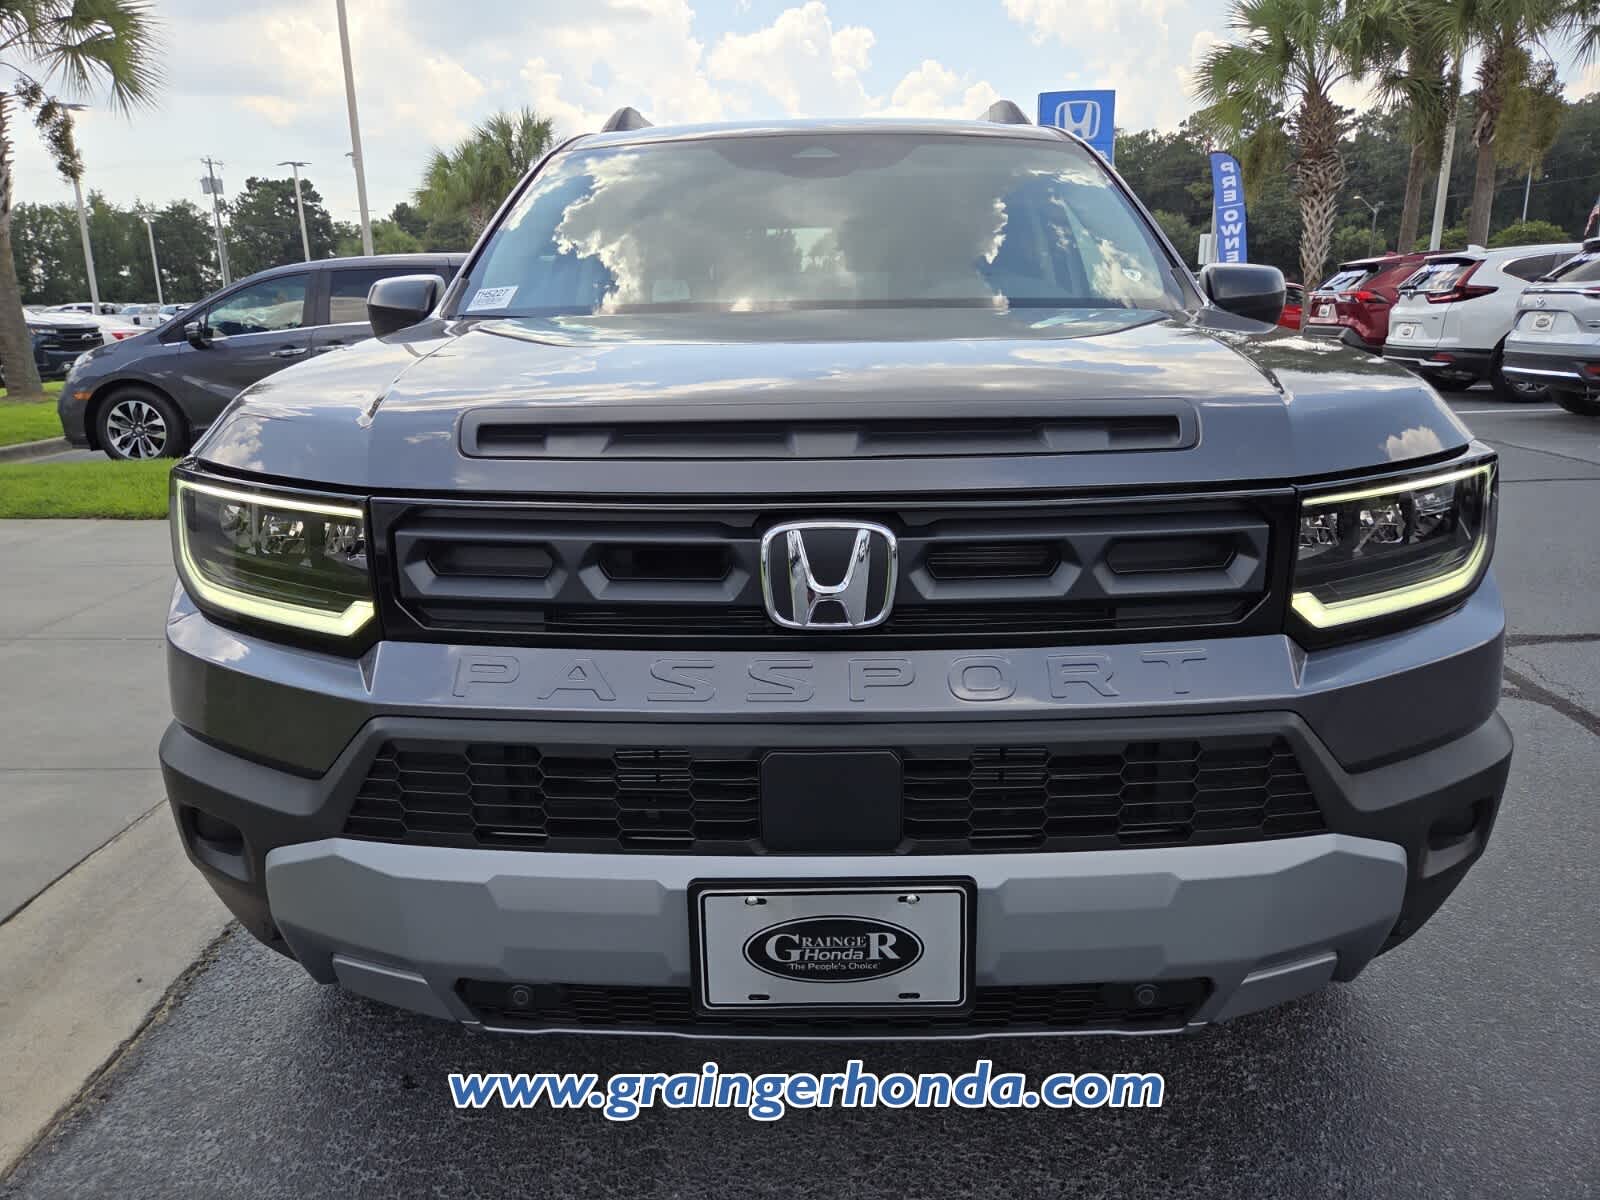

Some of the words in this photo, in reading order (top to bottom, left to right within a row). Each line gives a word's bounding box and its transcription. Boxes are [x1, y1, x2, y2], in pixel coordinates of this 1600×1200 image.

[452, 649, 1207, 702] PASSPORT
[765, 932, 900, 962] GRAINGER
[803, 949, 864, 961] Honda
[808, 962, 846, 971] People's
